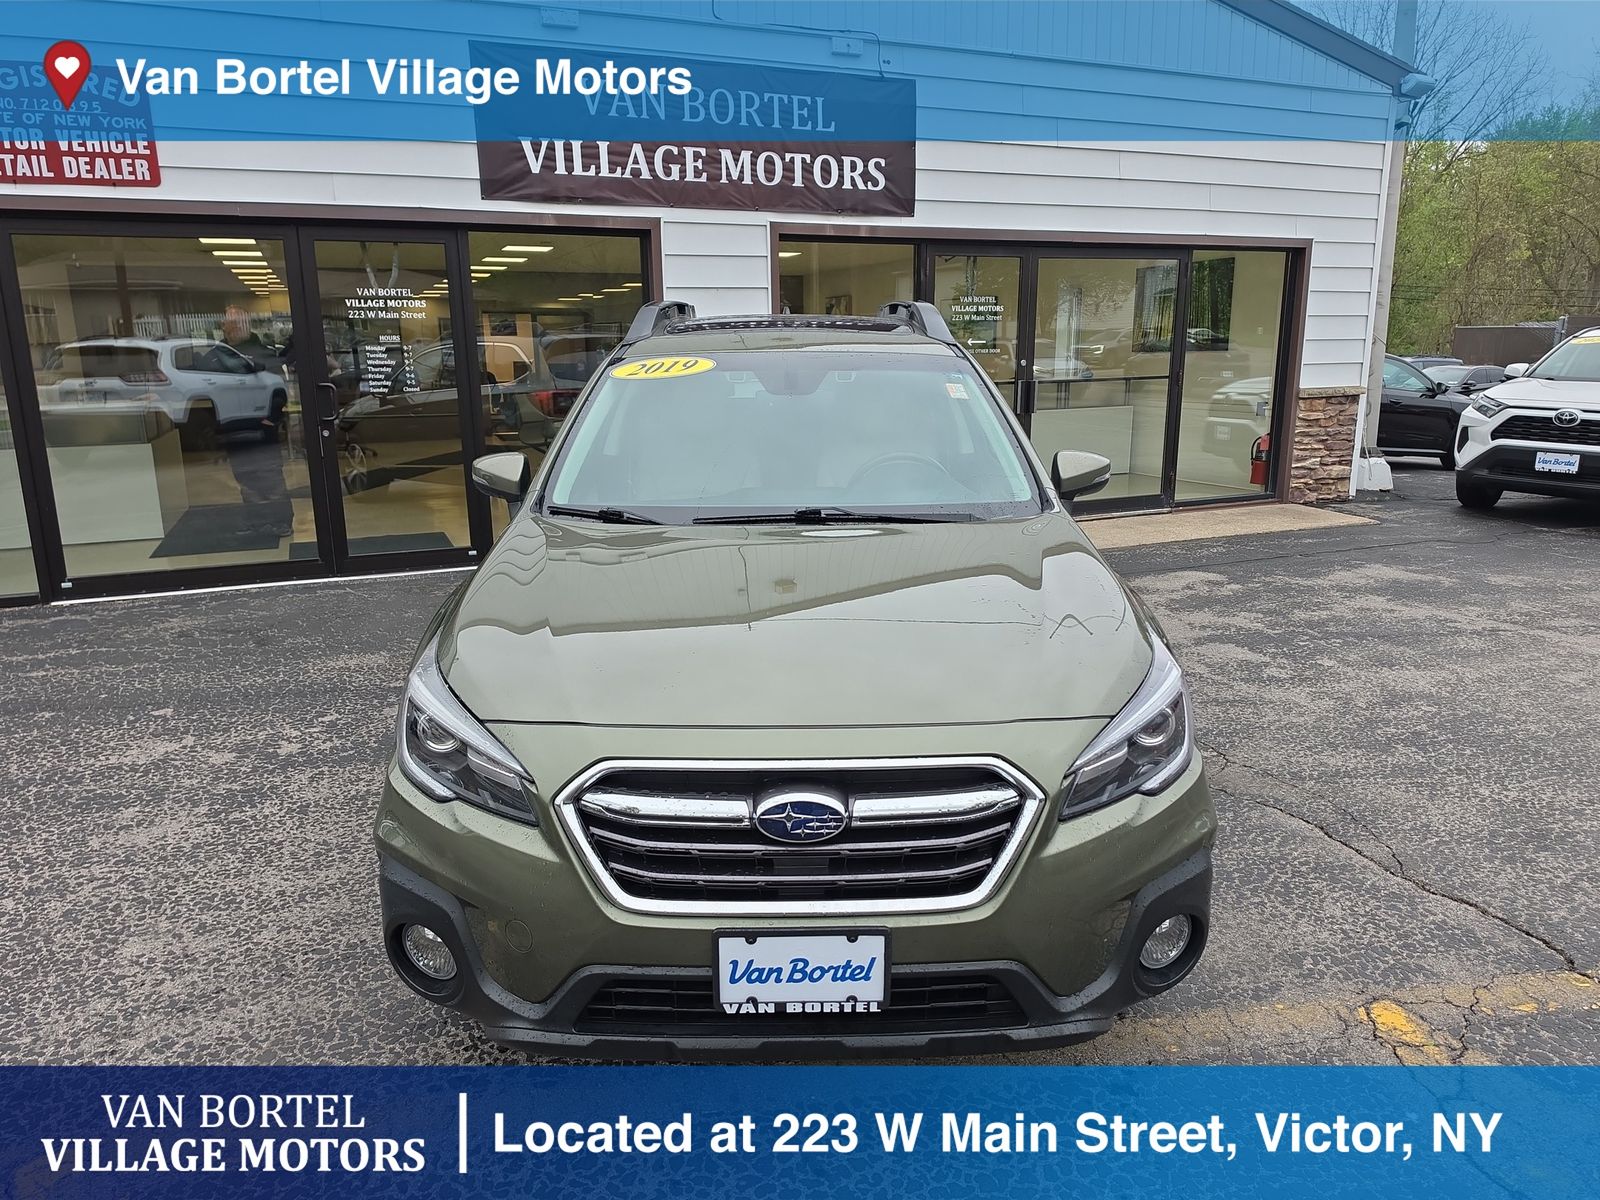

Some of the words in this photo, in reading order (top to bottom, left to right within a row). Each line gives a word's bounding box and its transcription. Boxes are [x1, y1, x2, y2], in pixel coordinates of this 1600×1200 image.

[580, 77, 667, 121] VAN
[682, 85, 836, 133] BORTEL
[22, 112, 46, 125] OF
[53, 113, 91, 127] NEW
[98, 115, 147, 130] YORK
[54, 128, 151, 155] VEHICLE
[0, 153, 55, 178] TAIL
[61, 155, 151, 181] DEALER
[518, 136, 708, 183] VILLAGE
[717, 147, 887, 192] MOTORS
[356, 287, 377, 297] VAN
[378, 288, 414, 297] BORTEL
[959, 295, 973, 303] VAN
[344, 298, 386, 308] VILLAGE
[386, 299, 427, 308] MOTORS
[348, 310, 365, 319] 223
[366, 310, 377, 319] W
[378, 310, 400, 319] Main
[400, 310, 427, 319] Street
[365, 345, 387, 353] Monday
[625, 359, 699, 377] 2019
[1537, 457, 1552, 465] Van
[1552, 458, 1578, 467] Bortel
[728, 958, 784, 985] Van
[785, 956, 877, 985] Bortel
[722, 1001, 775, 1014] VAN
[785, 1001, 882, 1013] BORTEL
